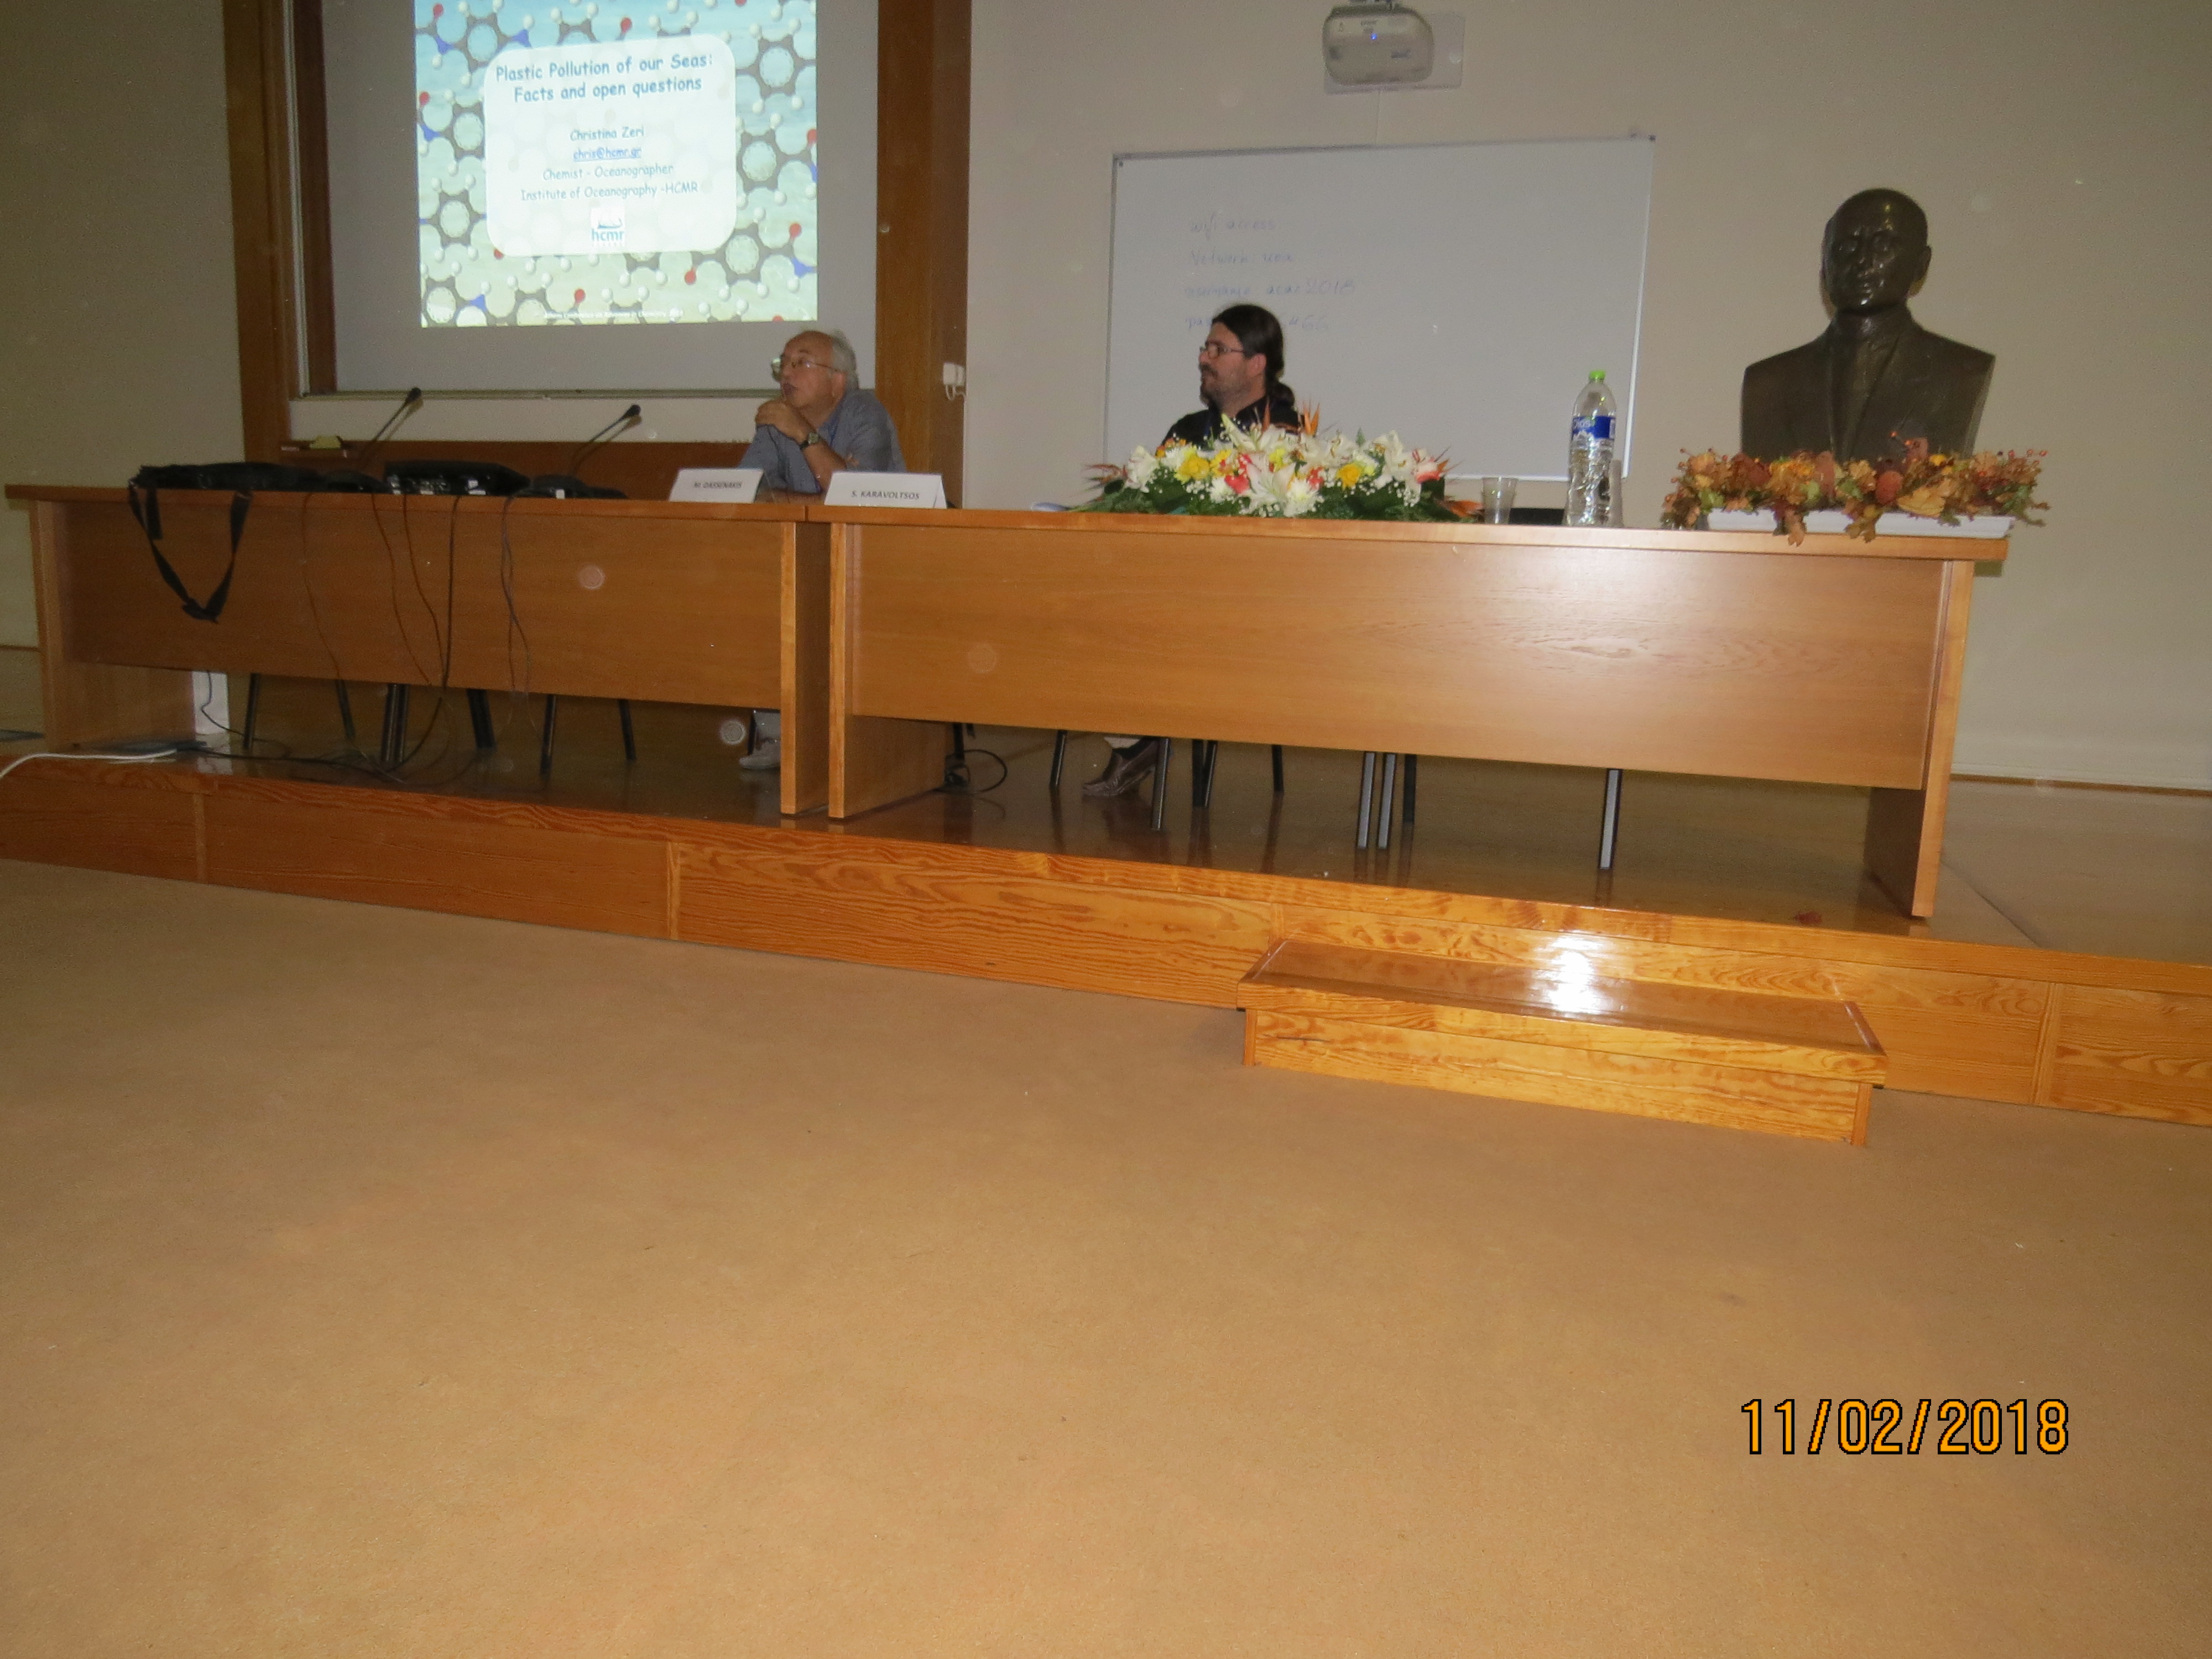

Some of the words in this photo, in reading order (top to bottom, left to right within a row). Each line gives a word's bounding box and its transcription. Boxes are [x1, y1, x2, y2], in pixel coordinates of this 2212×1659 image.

[496, 64, 543, 82] Plastic
[549, 59, 609, 79] Pollution
[616, 56, 632, 74] of
[639, 58, 664, 71] our
[670, 53, 713, 70] Seas:
[514, 86, 554, 102] Facts
[560, 82, 586, 100] and
[592, 83, 627, 101] open
[632, 76, 702, 98] questions
[569, 128, 618, 142] Christina
[621, 126, 645, 139] Zeri
[573, 147, 642, 161] chris@hcmr.gr
[542, 169, 584, 181] Chemist
[594, 163, 674, 179] Oceanographer
[520, 189, 567, 201] Institute
[570, 186, 581, 199] of
[583, 182, 657, 200] Oceanography
[591, 228, 625, 242] hcmr
[860, 490, 920, 499] KARAVOLTSOS
